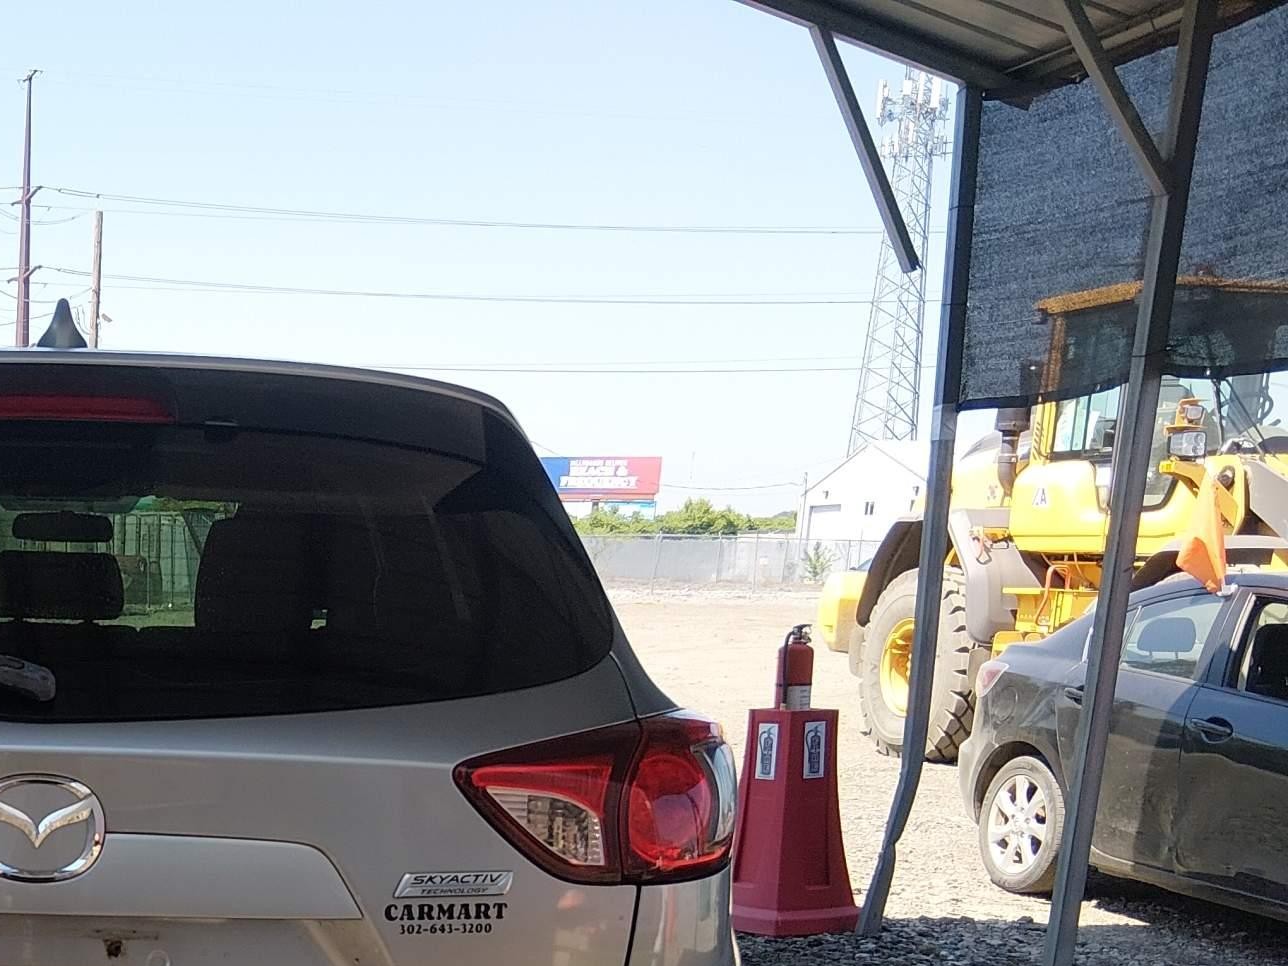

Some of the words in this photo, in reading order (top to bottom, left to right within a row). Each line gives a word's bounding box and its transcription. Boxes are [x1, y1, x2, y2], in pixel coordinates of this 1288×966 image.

[411, 874, 503, 885] SKYACTIV
[420, 887, 489, 895] TECHNOLOGY
[384, 902, 508, 921] CARMART
[399, 923, 492, 935] 302-643-3200
